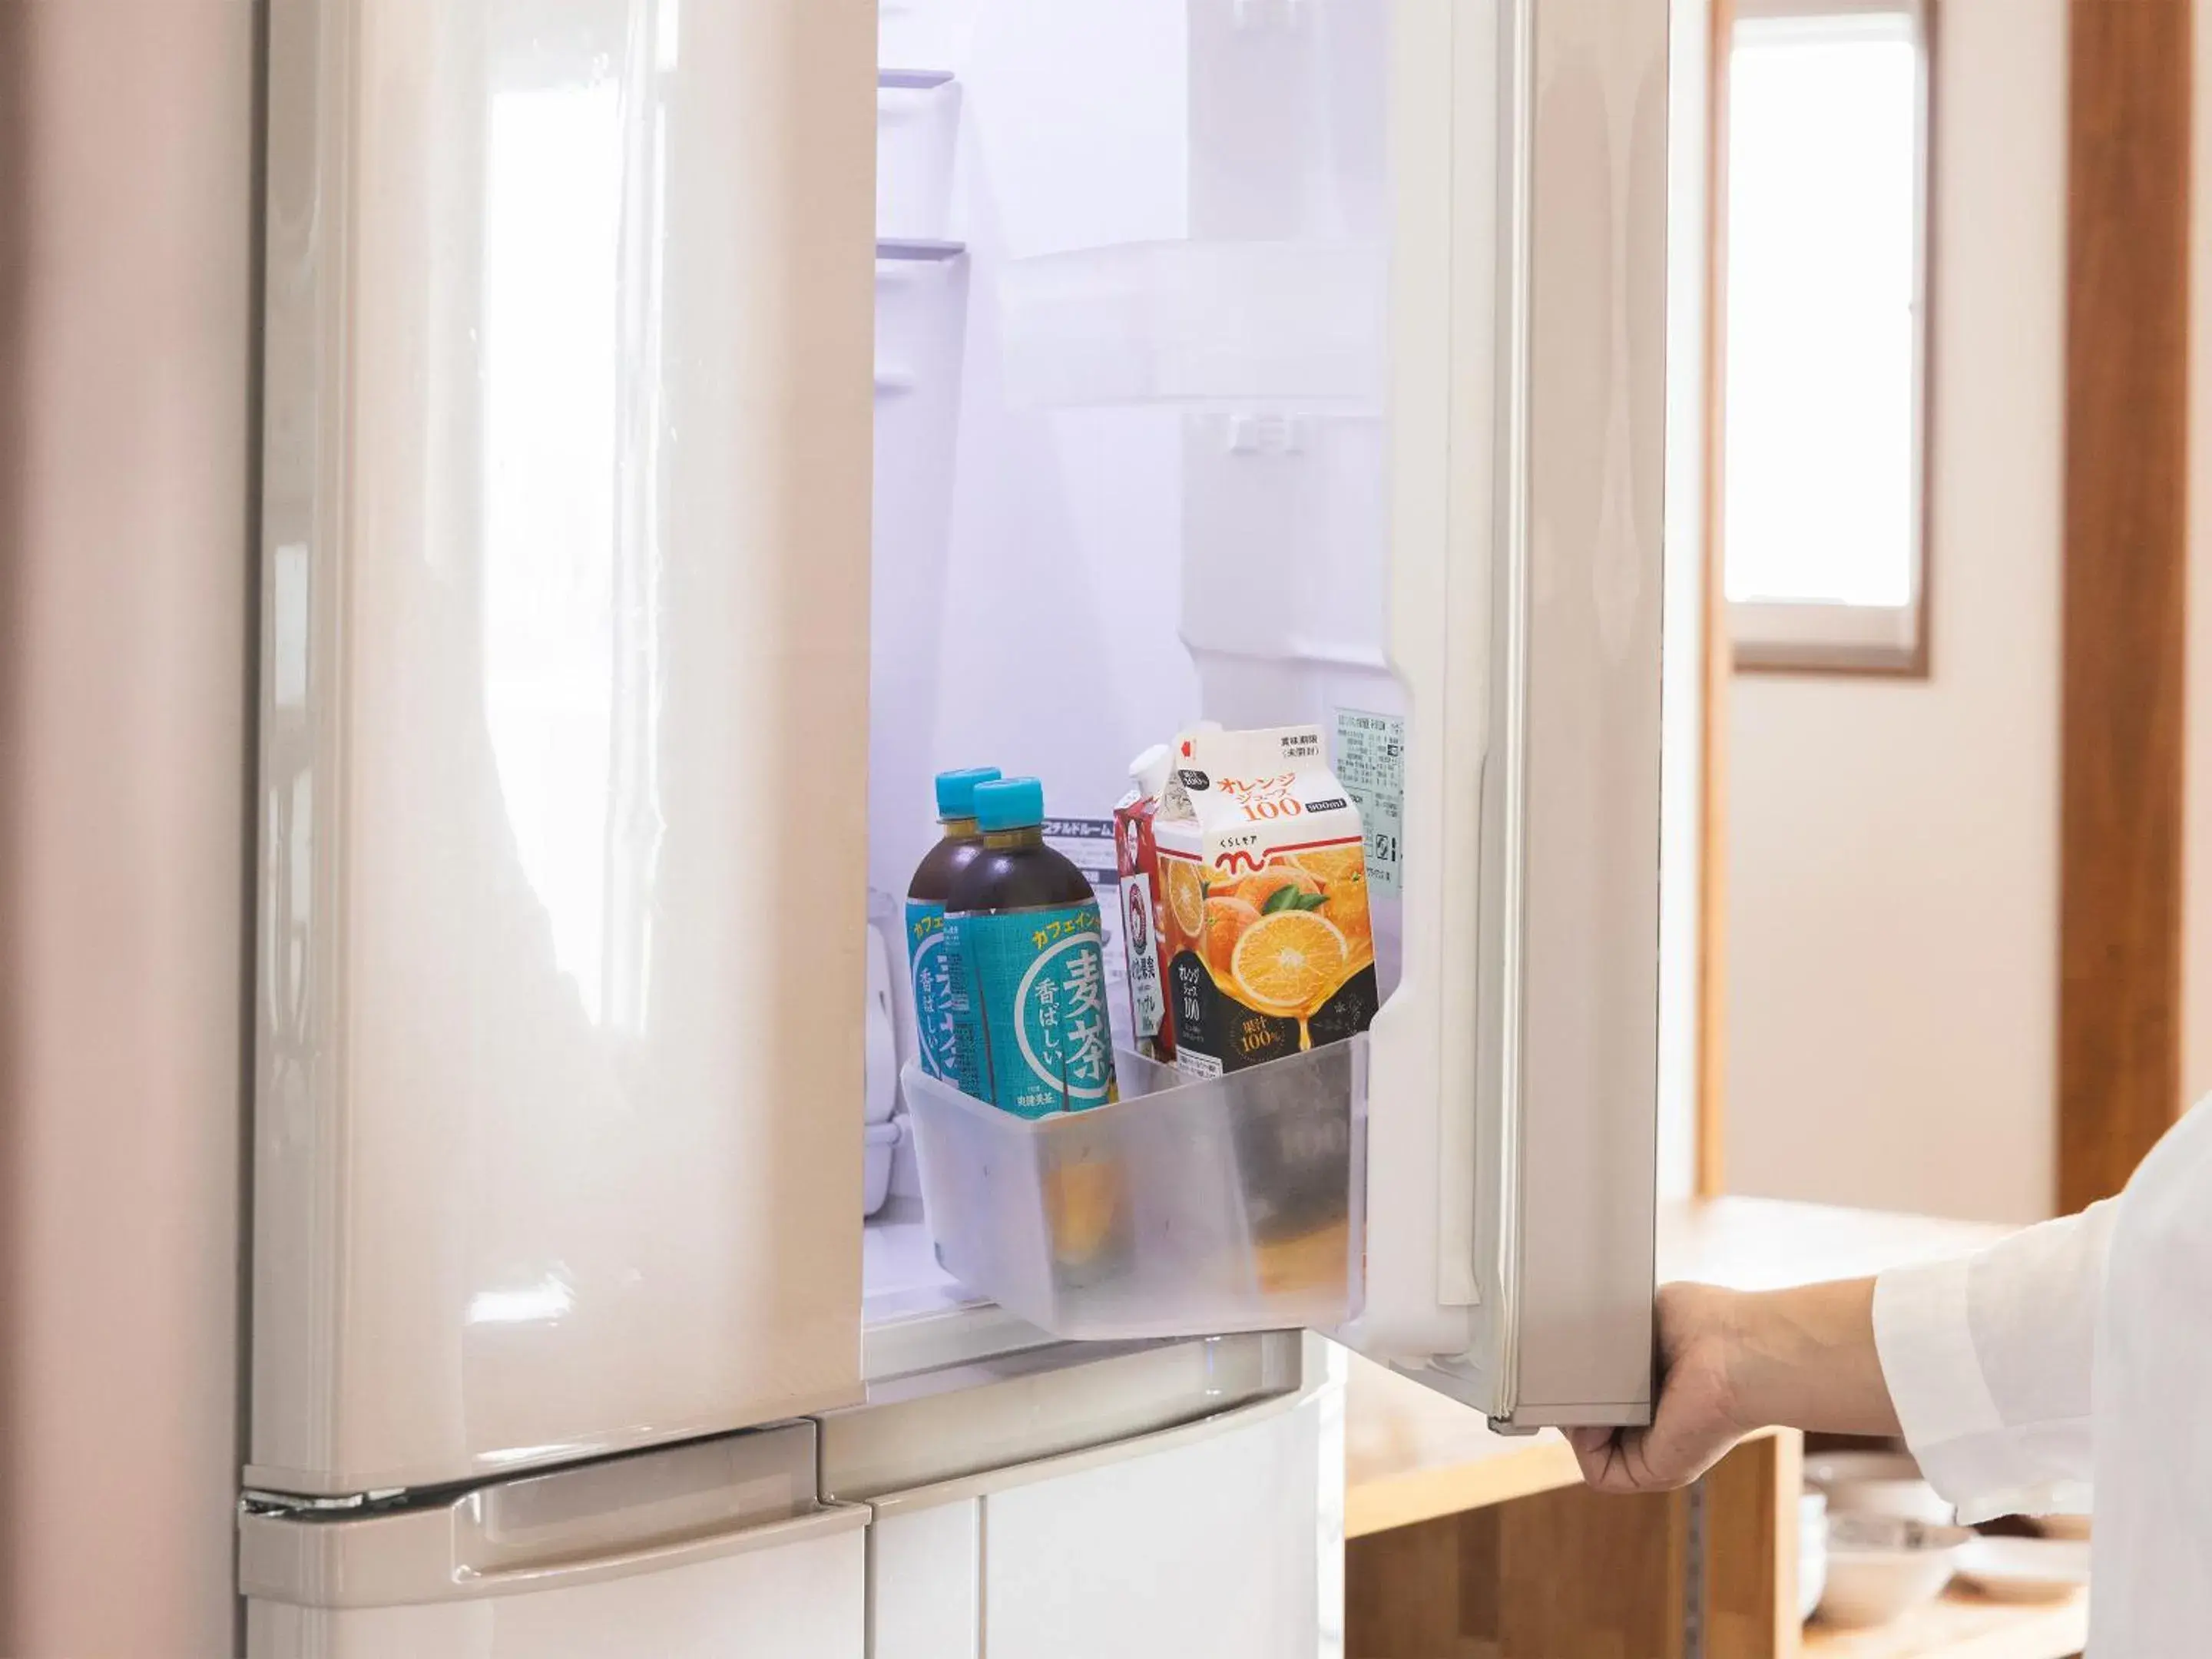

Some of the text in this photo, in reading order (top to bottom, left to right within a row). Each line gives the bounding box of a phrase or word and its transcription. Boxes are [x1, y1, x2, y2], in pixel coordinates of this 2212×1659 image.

[1280, 734, 1318, 747] 賞味期限
[1217, 772, 1296, 794] オレンジ
[1240, 797, 1302, 822] 100
[1220, 835, 1258, 846] くらしモア
[1032, 912, 1101, 949] カフェイン
[1035, 977, 1063, 1065] 香ばしい
[1063, 949, 1106, 1080] 麦茶
